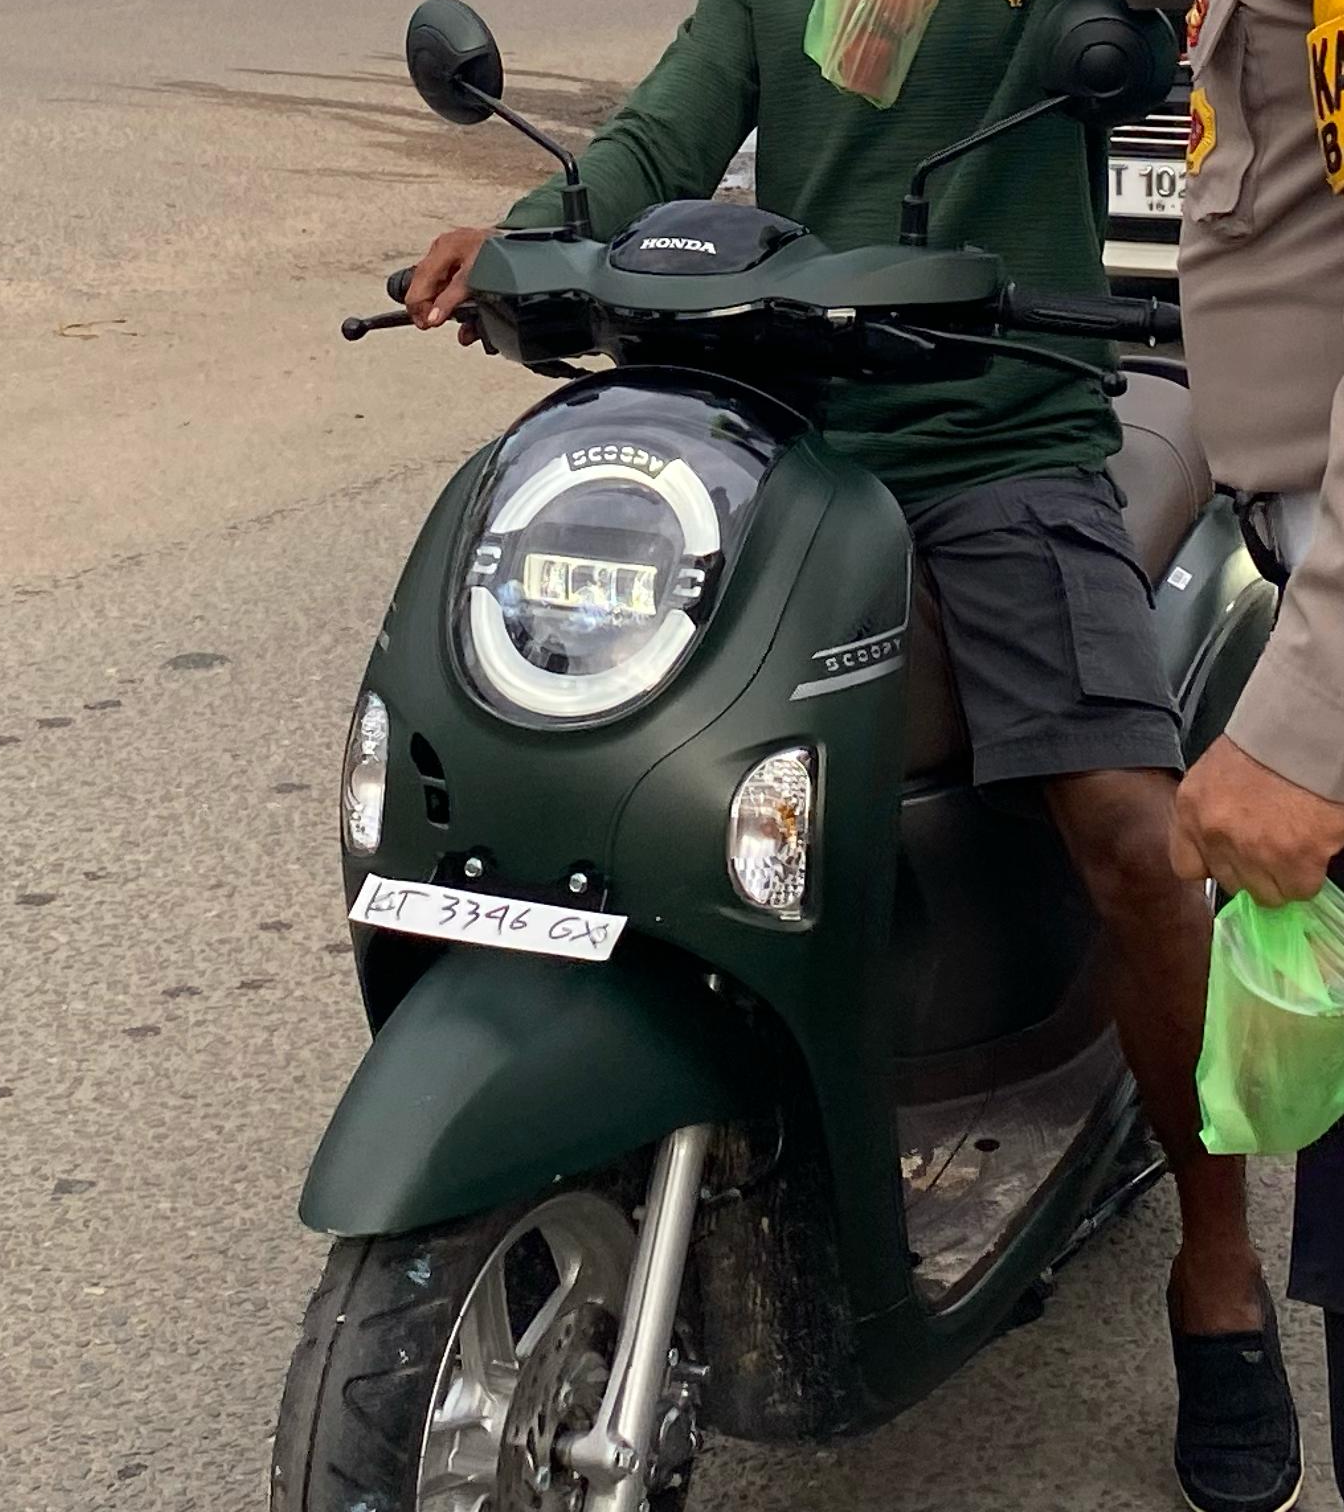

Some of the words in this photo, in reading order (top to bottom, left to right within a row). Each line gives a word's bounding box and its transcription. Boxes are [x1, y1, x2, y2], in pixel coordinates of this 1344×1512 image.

[640, 237, 717, 255] HONDA
[572, 445, 664, 472] SCOOPY
[825, 638, 901, 671] SCOOPY
[365, 882, 430, 920] KT
[439, 893, 531, 936] 3346
